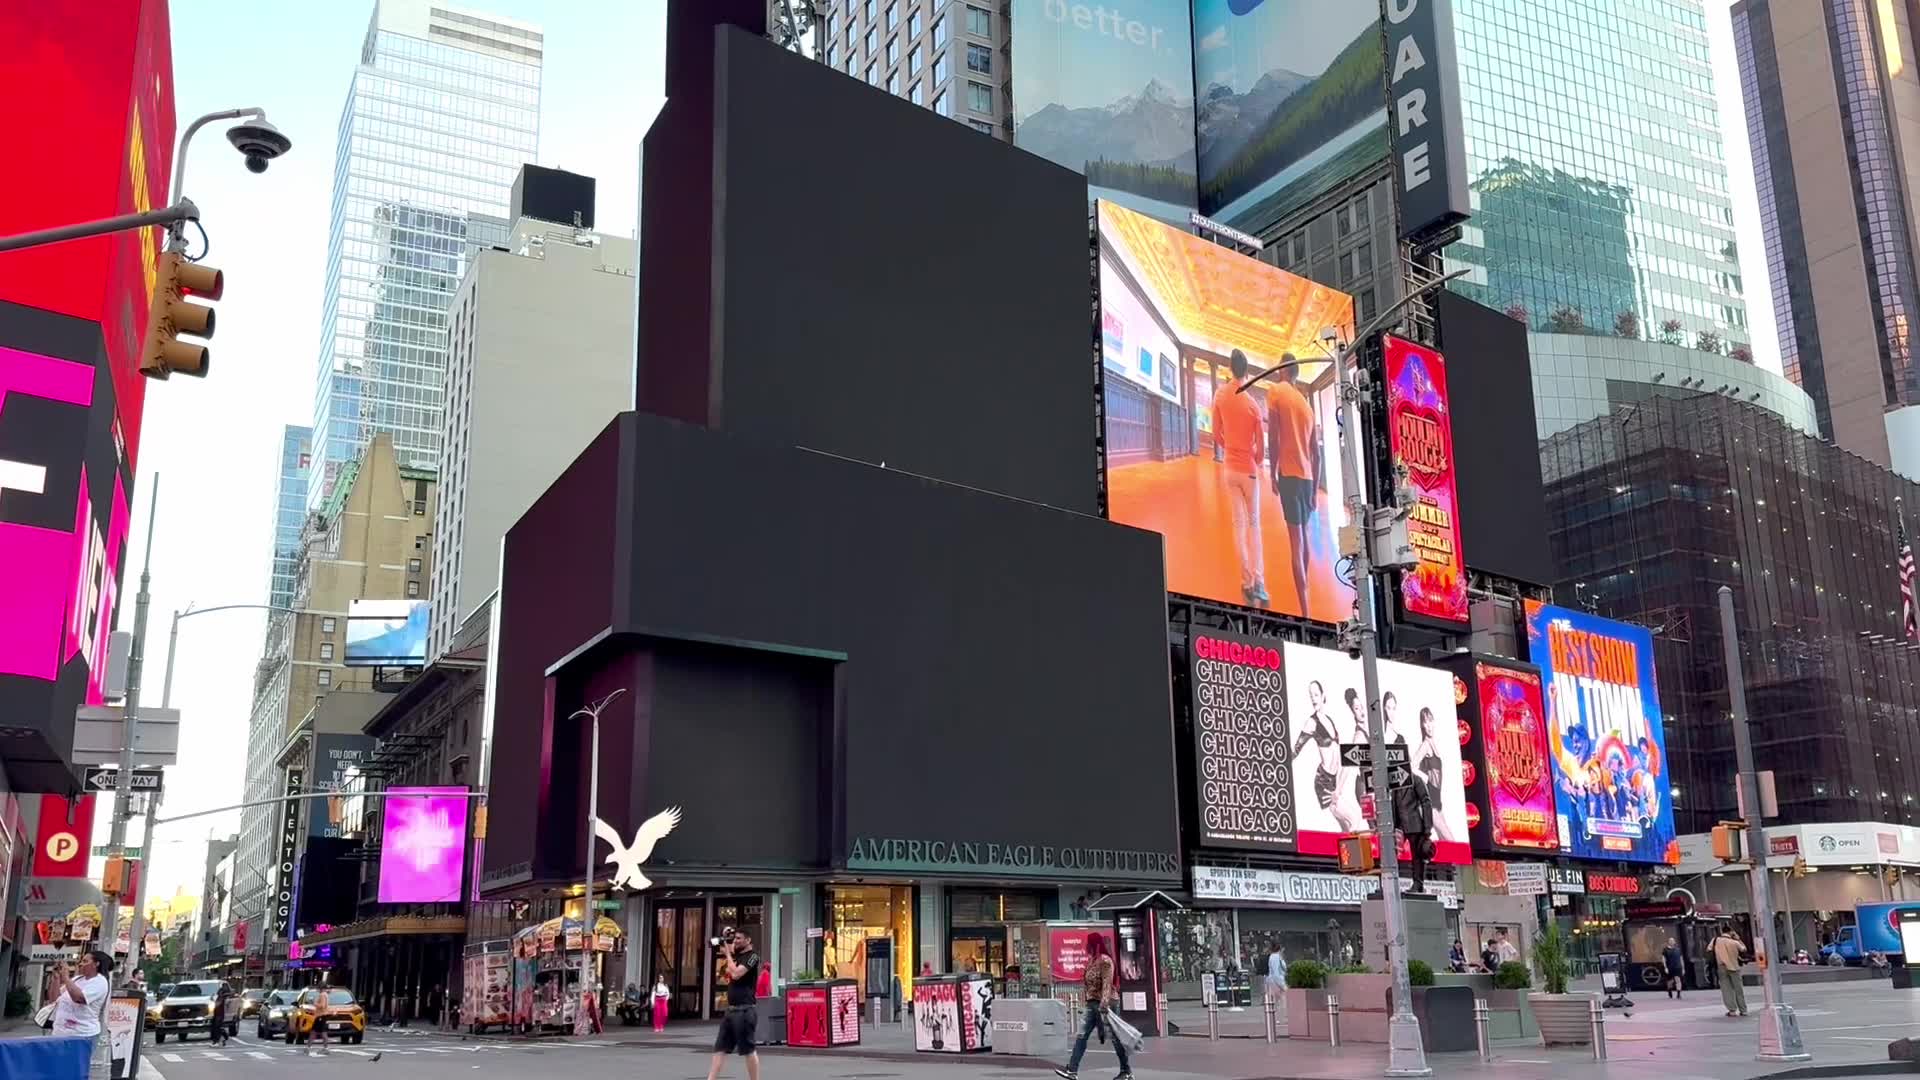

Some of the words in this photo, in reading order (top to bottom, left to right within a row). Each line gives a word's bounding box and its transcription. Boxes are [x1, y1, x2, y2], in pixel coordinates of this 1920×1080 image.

[1551, 618, 1573, 632] THE
[1195, 635, 1280, 671] CHICAGO
[1548, 622, 1592, 678] BEST
[1589, 632, 1638, 688] SHOW
[1196, 659, 1282, 693] CHICAGO
[1198, 683, 1284, 717] CHICAGO
[1553, 671, 1580, 736] IN
[1578, 676, 1646, 747] TOWN
[1199, 707, 1286, 740] CHICAGO
[329, 750, 342, 759] YOU
[1200, 732, 1288, 764] CHICAGO
[1351, 750, 1370, 760] ONE
[1387, 749, 1400, 760] AY
[97, 775, 117, 785] ONE
[130, 776, 153, 785] WAY
[1201, 757, 1289, 787] CHICAGO
[1203, 781, 1291, 811] CHICAGO
[1204, 805, 1292, 836] CHICAGO
[55, 838, 72, 857] P
[851, 838, 981, 864] AMERICAN
[987, 843, 1054, 867] EAGLE
[1060, 848, 1179, 873] OUTFITTERS
[1209, 868, 1231, 878] SPORTS
[1231, 869, 1243, 879] FAN
[1243, 870, 1257, 879] SHOP
[1566, 868, 1584, 884] FIN
[32, 952, 65, 961] MARQUIS
[914, 983, 956, 1002] CHICAGO
[961, 981, 977, 1049] CHICAGO
